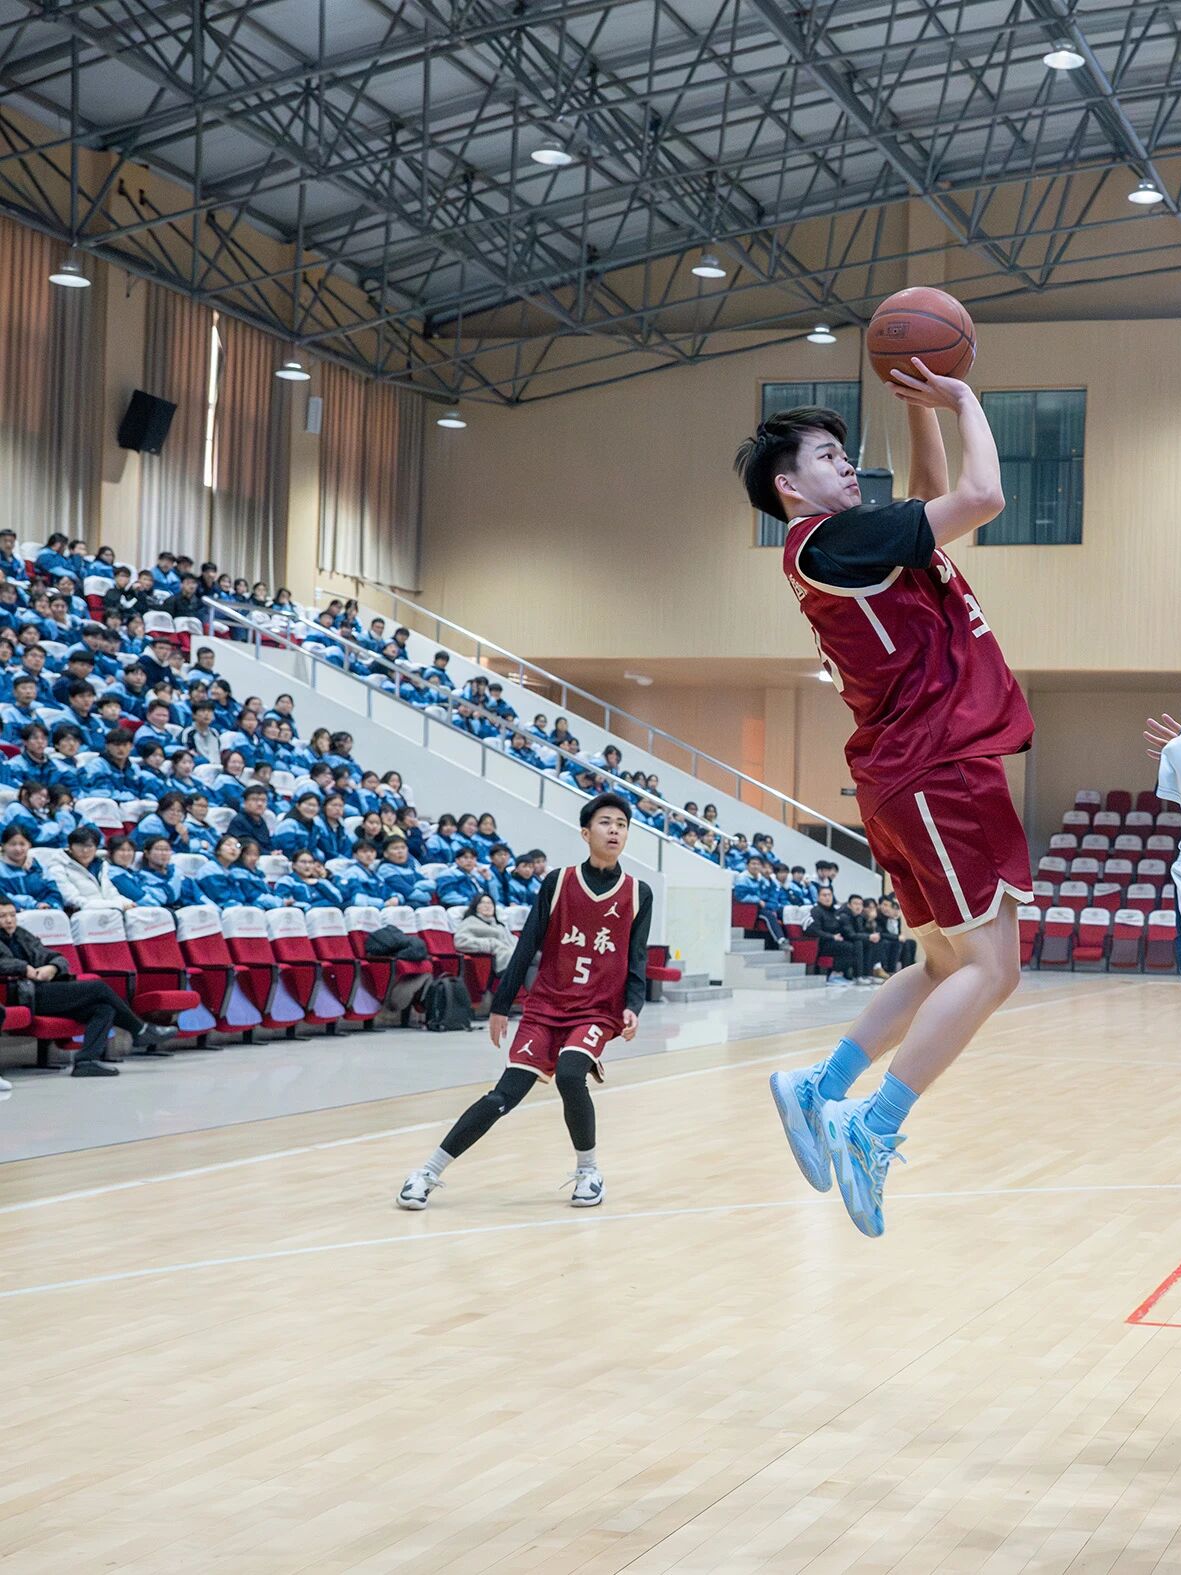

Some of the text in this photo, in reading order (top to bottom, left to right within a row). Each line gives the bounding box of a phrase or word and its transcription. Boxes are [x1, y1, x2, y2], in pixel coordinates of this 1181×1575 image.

[561, 925, 616, 954] 山东
[573, 957, 592, 984] 5
[583, 1024, 604, 1047] 5
